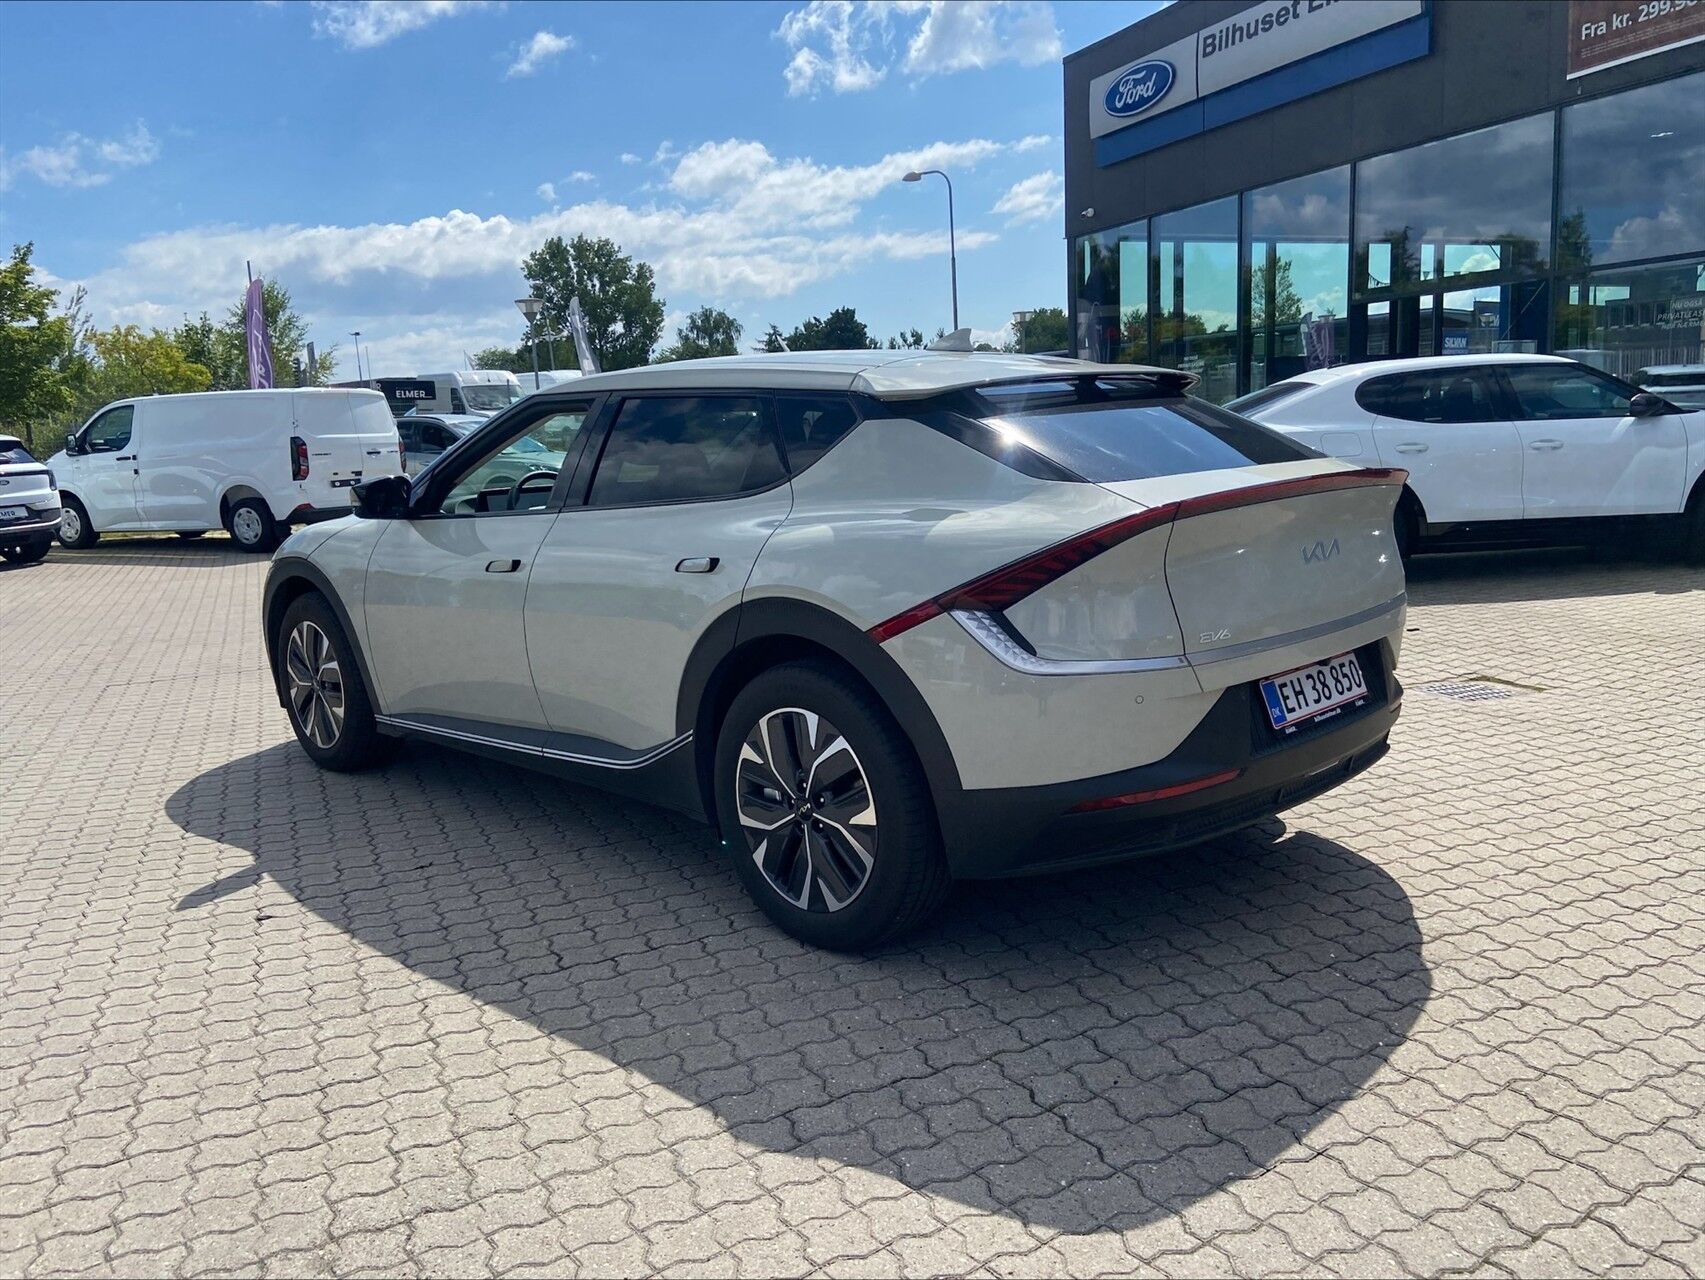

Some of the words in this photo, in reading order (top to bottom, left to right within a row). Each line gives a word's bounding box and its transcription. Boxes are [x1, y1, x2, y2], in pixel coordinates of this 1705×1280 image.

[1202, 1, 1300, 58] Bilhuset
[1581, 21, 1607, 40] Fra
[1612, 13, 1632, 30] kr.
[1115, 70, 1157, 109] Ford
[395, 390, 426, 398] ELMER
[1301, 537, 1340, 565] KIA
[1200, 629, 1231, 644] EV6
[1278, 677, 1309, 715] EH
[1305, 669, 1332, 705] 38
[1329, 659, 1362, 696] 850
